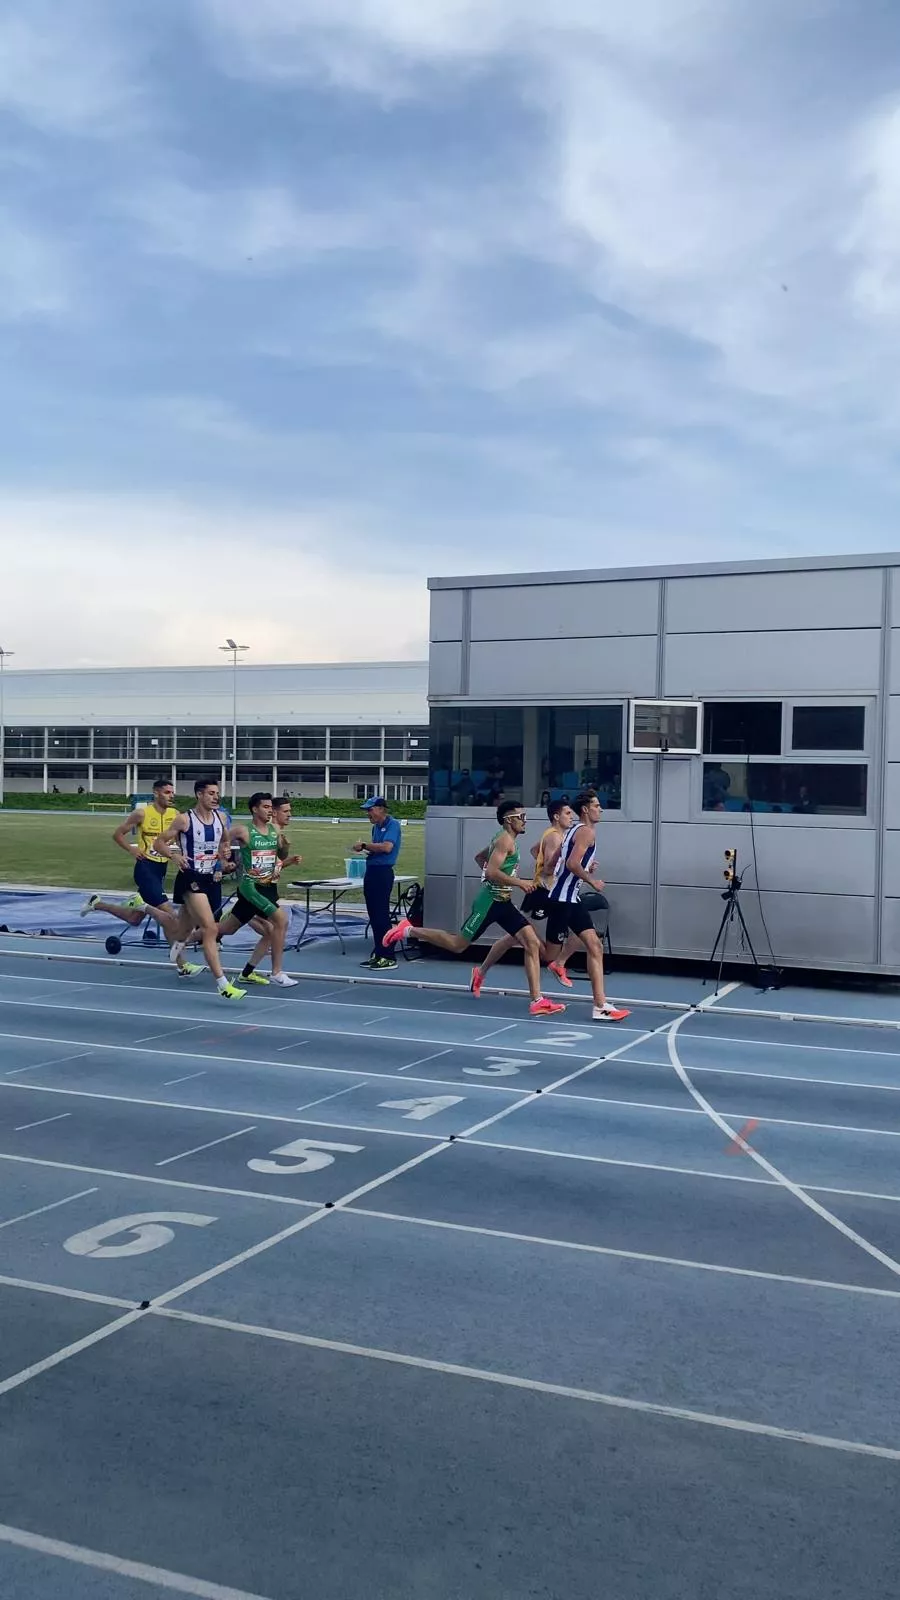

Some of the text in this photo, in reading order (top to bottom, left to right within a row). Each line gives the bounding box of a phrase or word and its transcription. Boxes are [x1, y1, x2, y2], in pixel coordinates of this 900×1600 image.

[525, 1031, 593, 1047] 2
[462, 1056, 541, 1077] 3
[377, 1095, 466, 1121] 4
[247, 1138, 365, 1174] 5
[63, 1211, 219, 1258] 6
